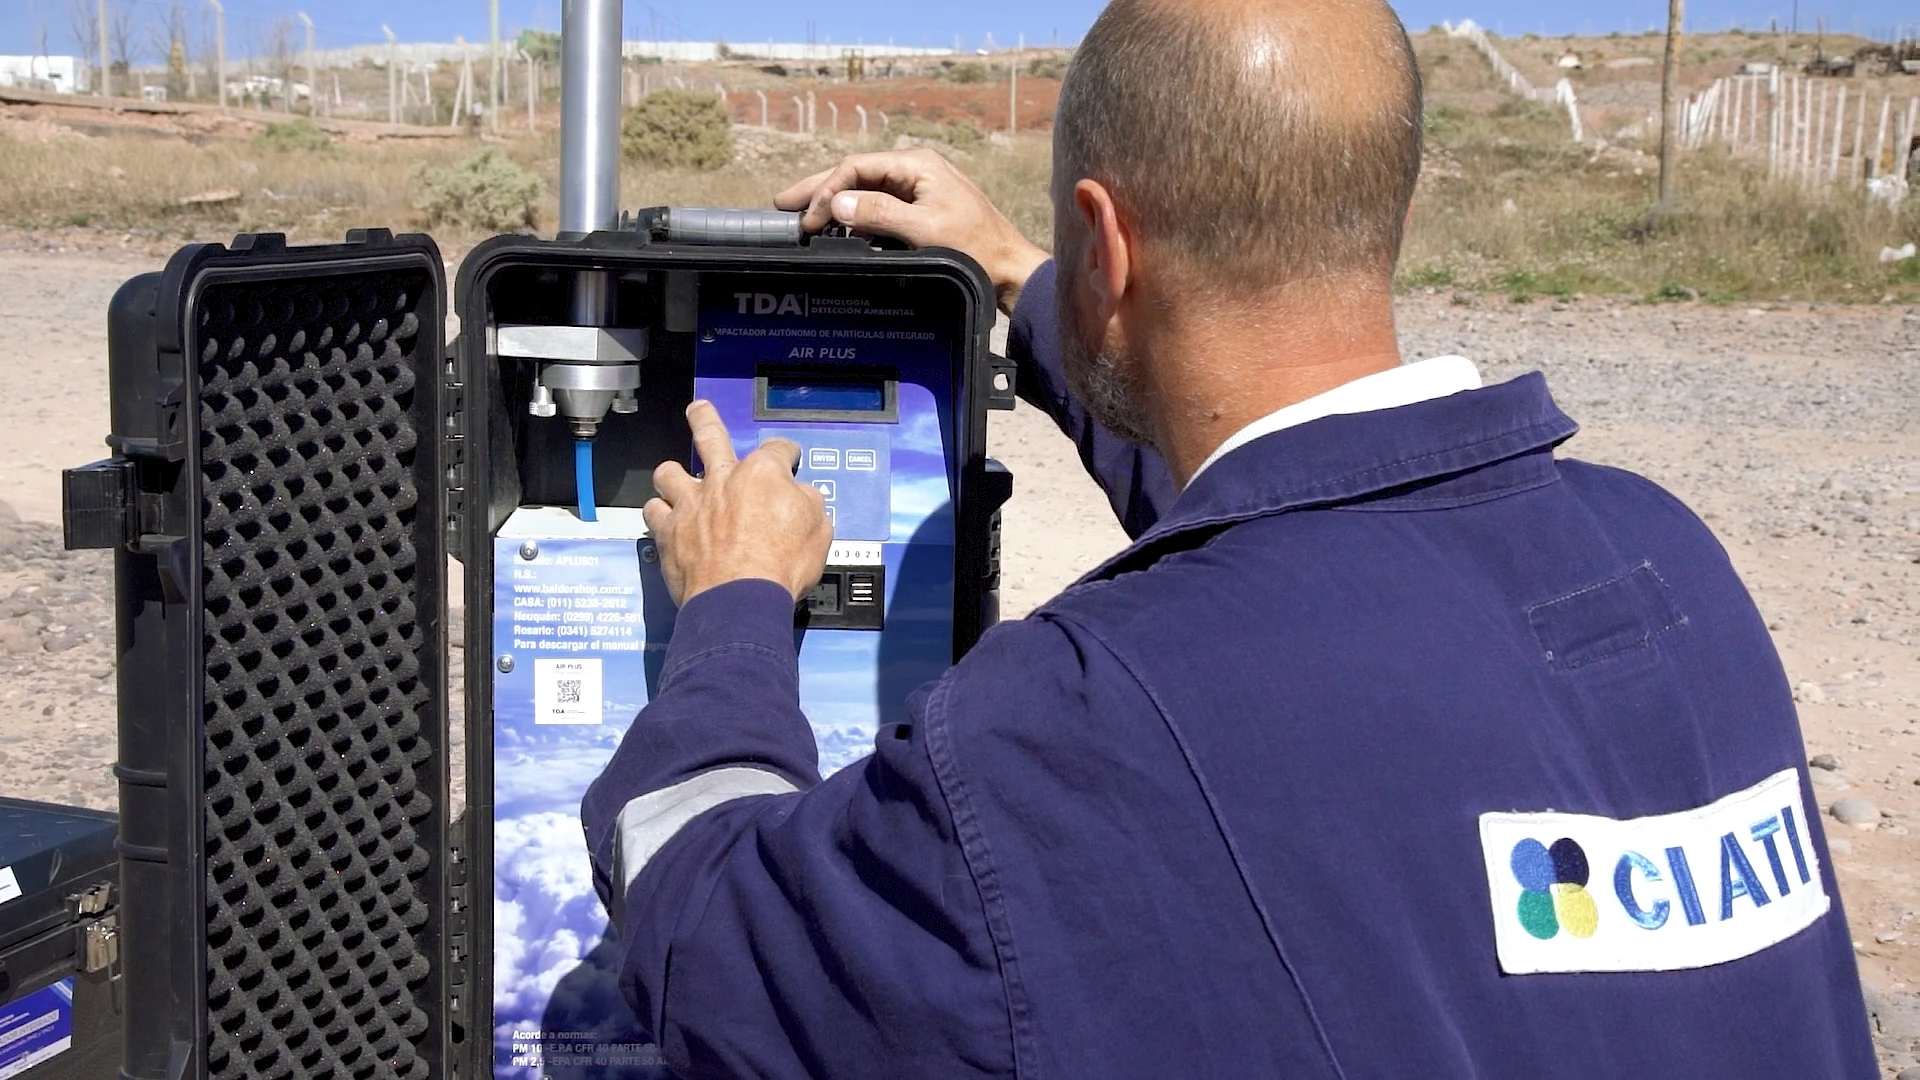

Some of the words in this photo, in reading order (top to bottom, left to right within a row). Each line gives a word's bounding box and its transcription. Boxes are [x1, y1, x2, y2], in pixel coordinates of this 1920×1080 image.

[734, 293, 802, 315] TDA
[713, 328, 767, 337] MPACTADOR
[819, 329, 831, 338] DE
[832, 328, 885, 339] PARTÍCULAS
[886, 331, 935, 340] INTEGRADO
[788, 347, 814, 359] AIR
[819, 348, 857, 359] PLUS
[514, 584, 634, 596] www.baldorshop.com.ar
[514, 597, 544, 608] CABA:
[547, 597, 572, 609] (011)
[514, 625, 554, 636] Rosario:
[557, 626, 588, 637] (0341)
[514, 639, 540, 650] Para
[542, 640, 589, 652] descargar
[590, 640, 600, 650] el
[602, 640, 639, 650] manual
[1613, 805, 1812, 931] CIATI
[512, 1030, 548, 1040] Acorde
[549, 1032, 555, 1040] a
[557, 1032, 598, 1040] normas:
[512, 1044, 528, 1053] PM
[530, 1044, 543, 1053] 10
[575, 1043, 594, 1053] CFR
[596, 1043, 609, 1053] 40
[611, 1043, 642, 1053] PARTE
[512, 1057, 528, 1066] PM
[573, 1057, 592, 1066] CFR
[595, 1057, 607, 1066] 40
[609, 1057, 641, 1066] PARTE
[642, 1057, 654, 1066] 50
